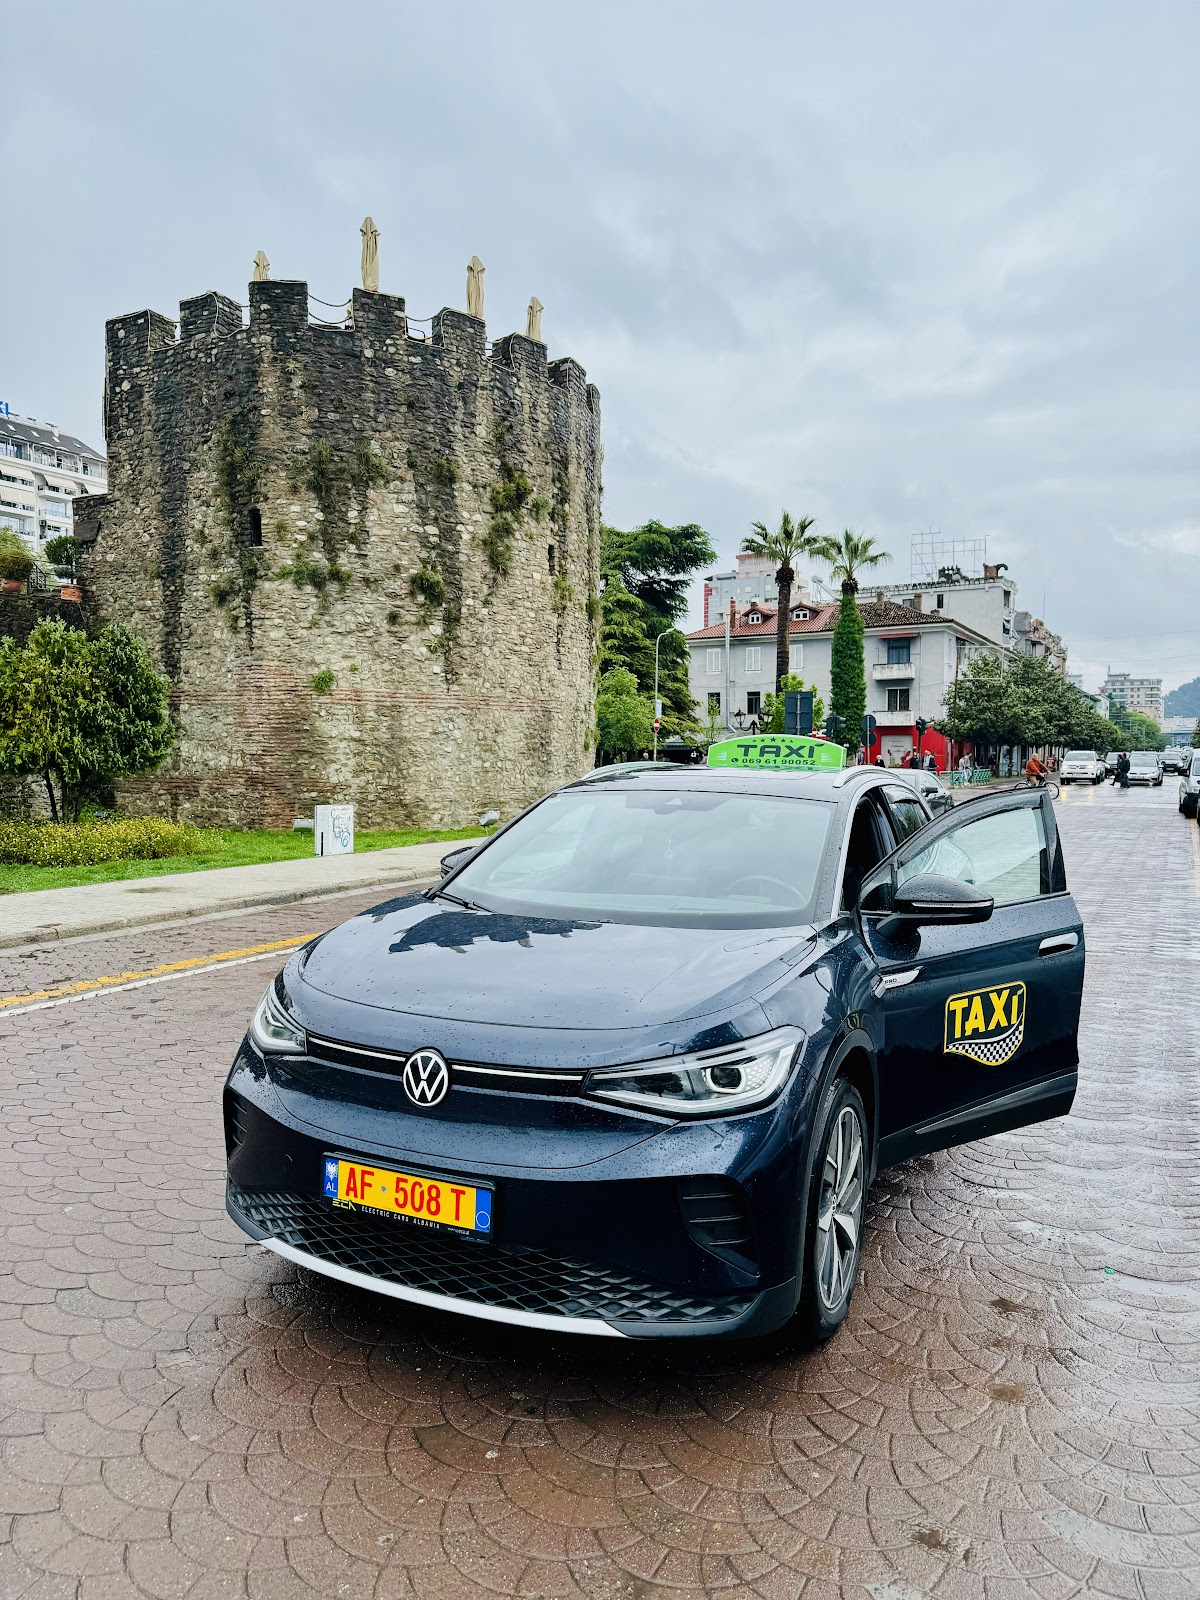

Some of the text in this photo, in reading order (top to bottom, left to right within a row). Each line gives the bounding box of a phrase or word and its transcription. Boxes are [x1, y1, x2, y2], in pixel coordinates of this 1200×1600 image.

[325, 1182, 337, 1193] AL
[345, 1167, 466, 1221] AF 508 T
[361, 1205, 440, 1230] ELECTRIC CARS ALBANIA
